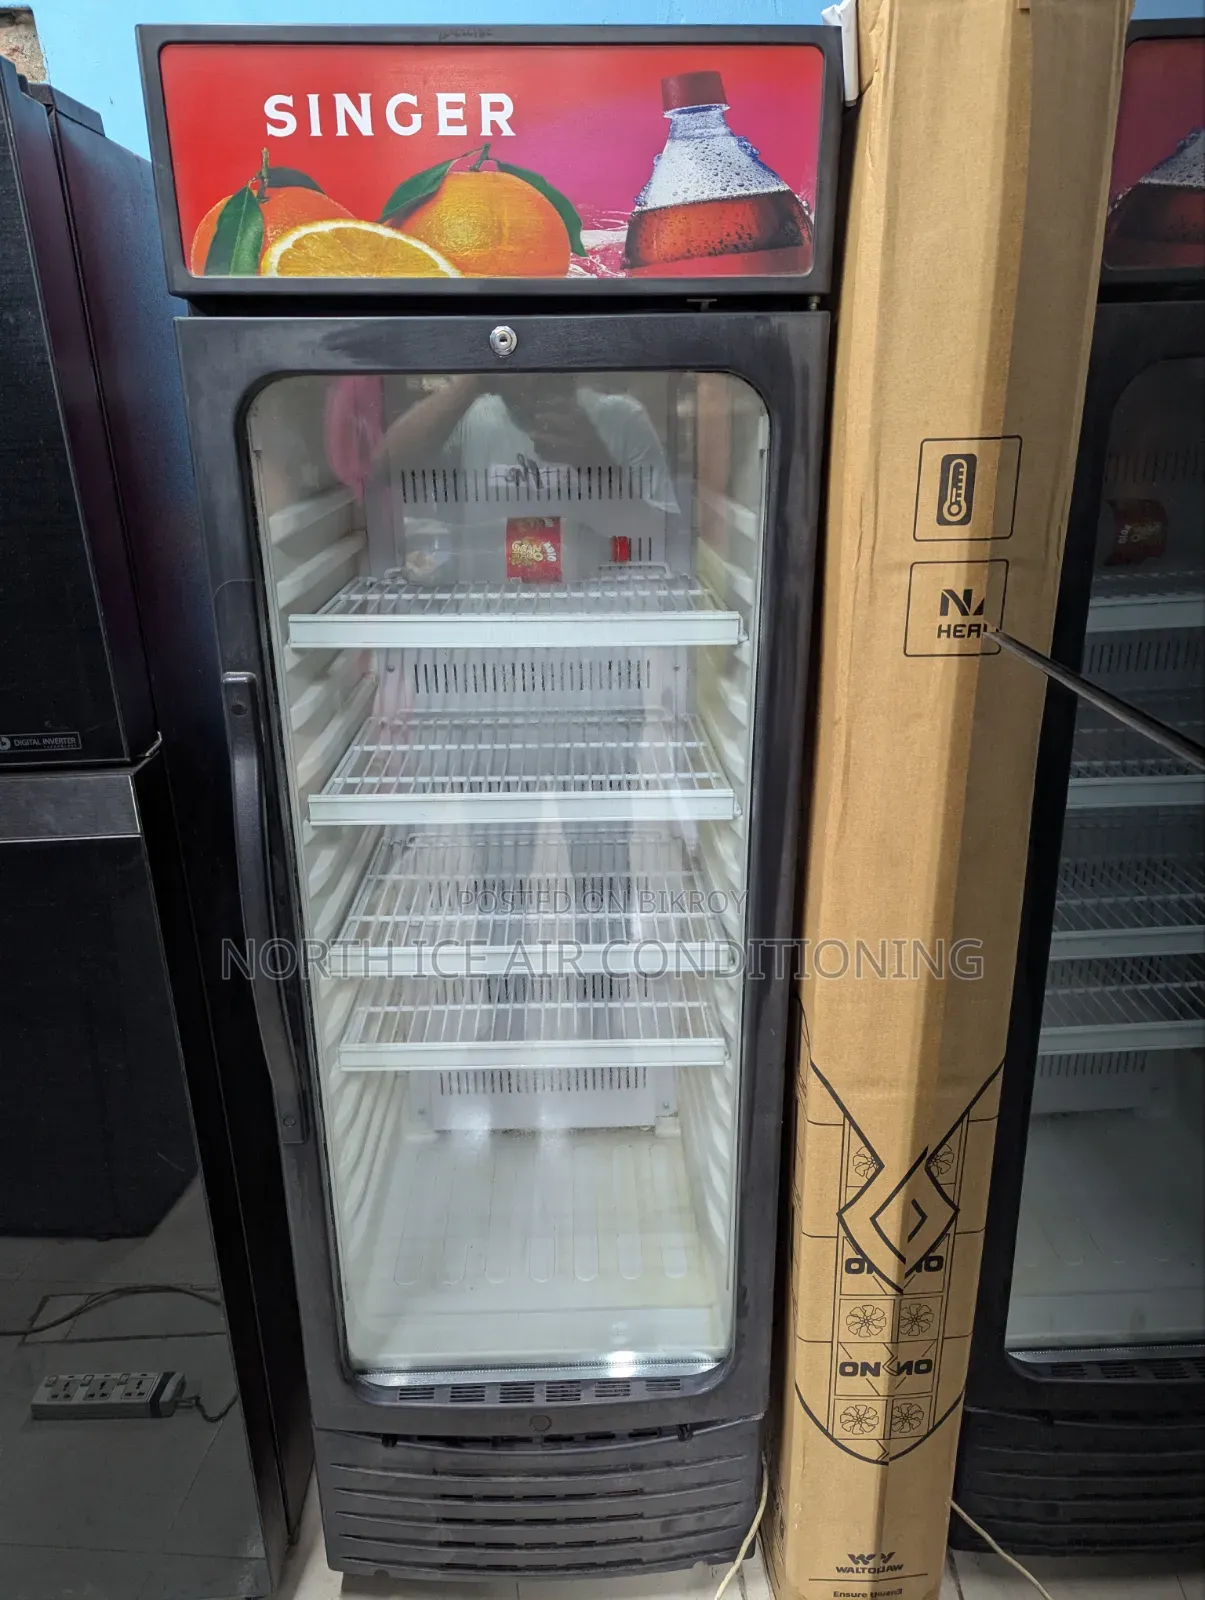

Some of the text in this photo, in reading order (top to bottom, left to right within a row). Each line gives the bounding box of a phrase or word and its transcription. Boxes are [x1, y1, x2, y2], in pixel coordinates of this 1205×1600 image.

[264, 92, 516, 137] SINGER
[14, 739, 40, 747] DIGITAL
[834, 1589, 867, 1598] Ensure
